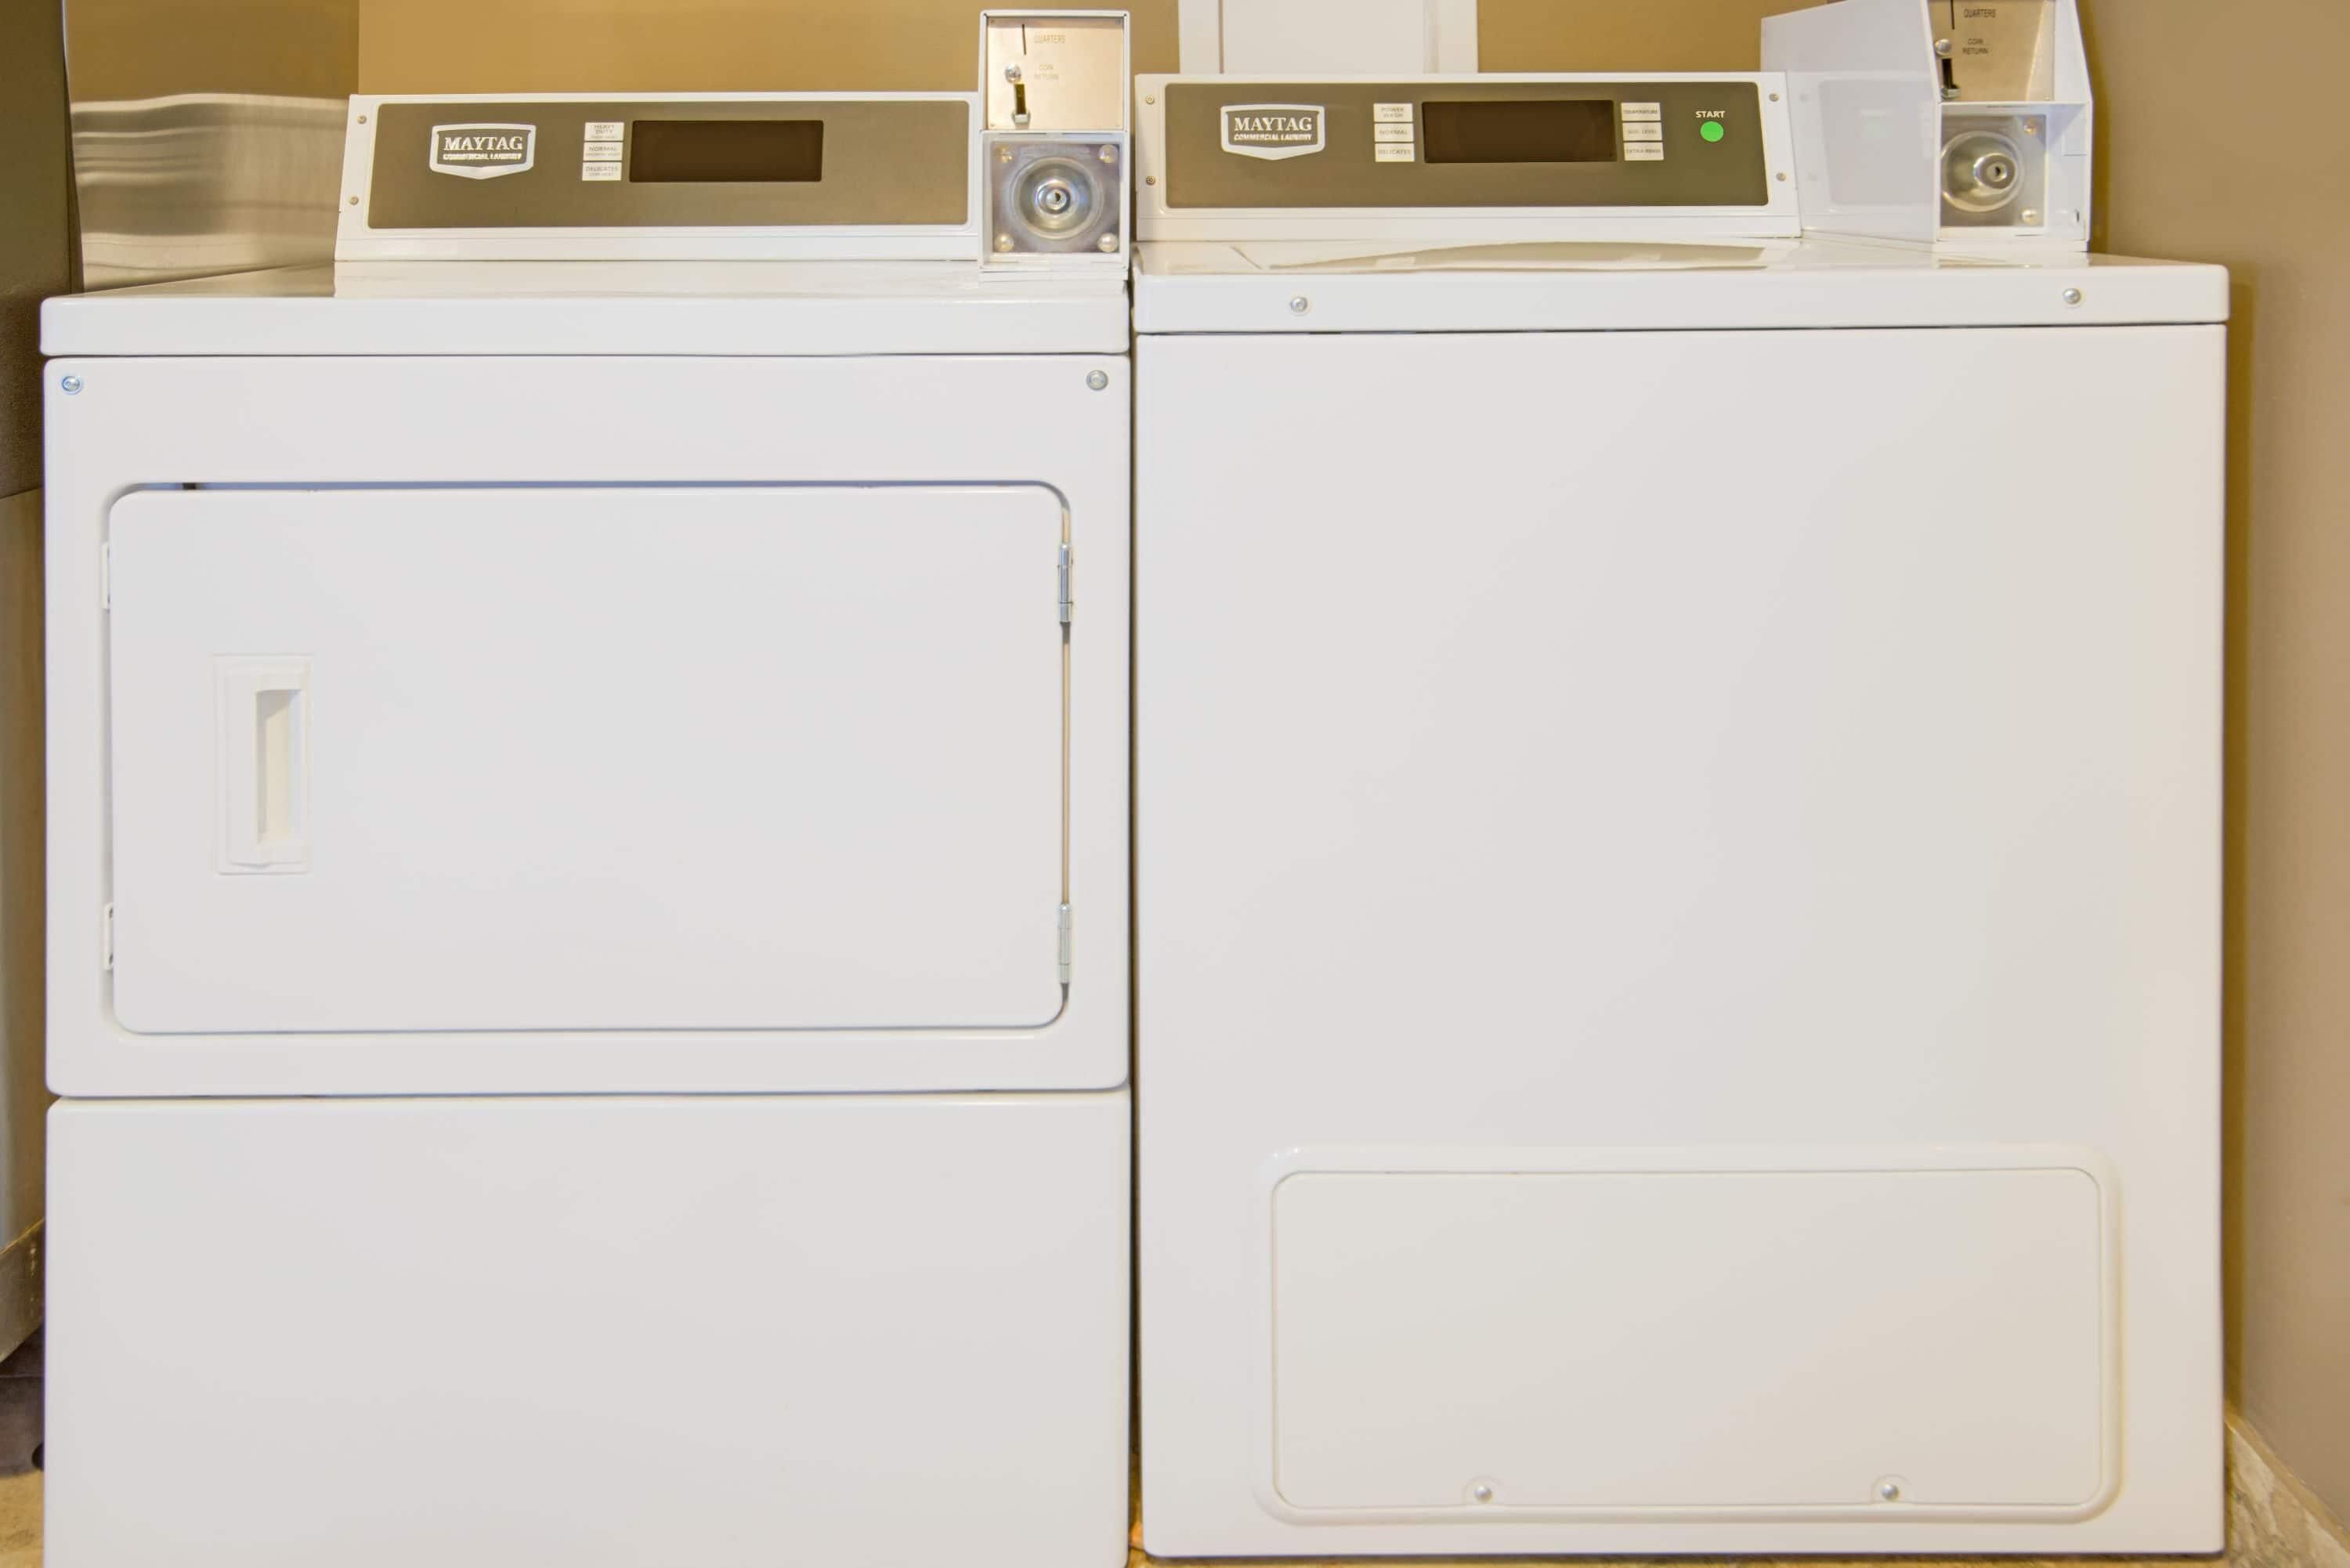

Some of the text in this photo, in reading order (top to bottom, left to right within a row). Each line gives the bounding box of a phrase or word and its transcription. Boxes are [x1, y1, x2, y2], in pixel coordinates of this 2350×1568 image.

[1963, 9, 1996, 18] QUARTERS
[1033, 34, 1065, 44] QUARTERS
[1234, 117, 1312, 131] MAYTAG
[443, 136, 523, 150] MAYTAG
